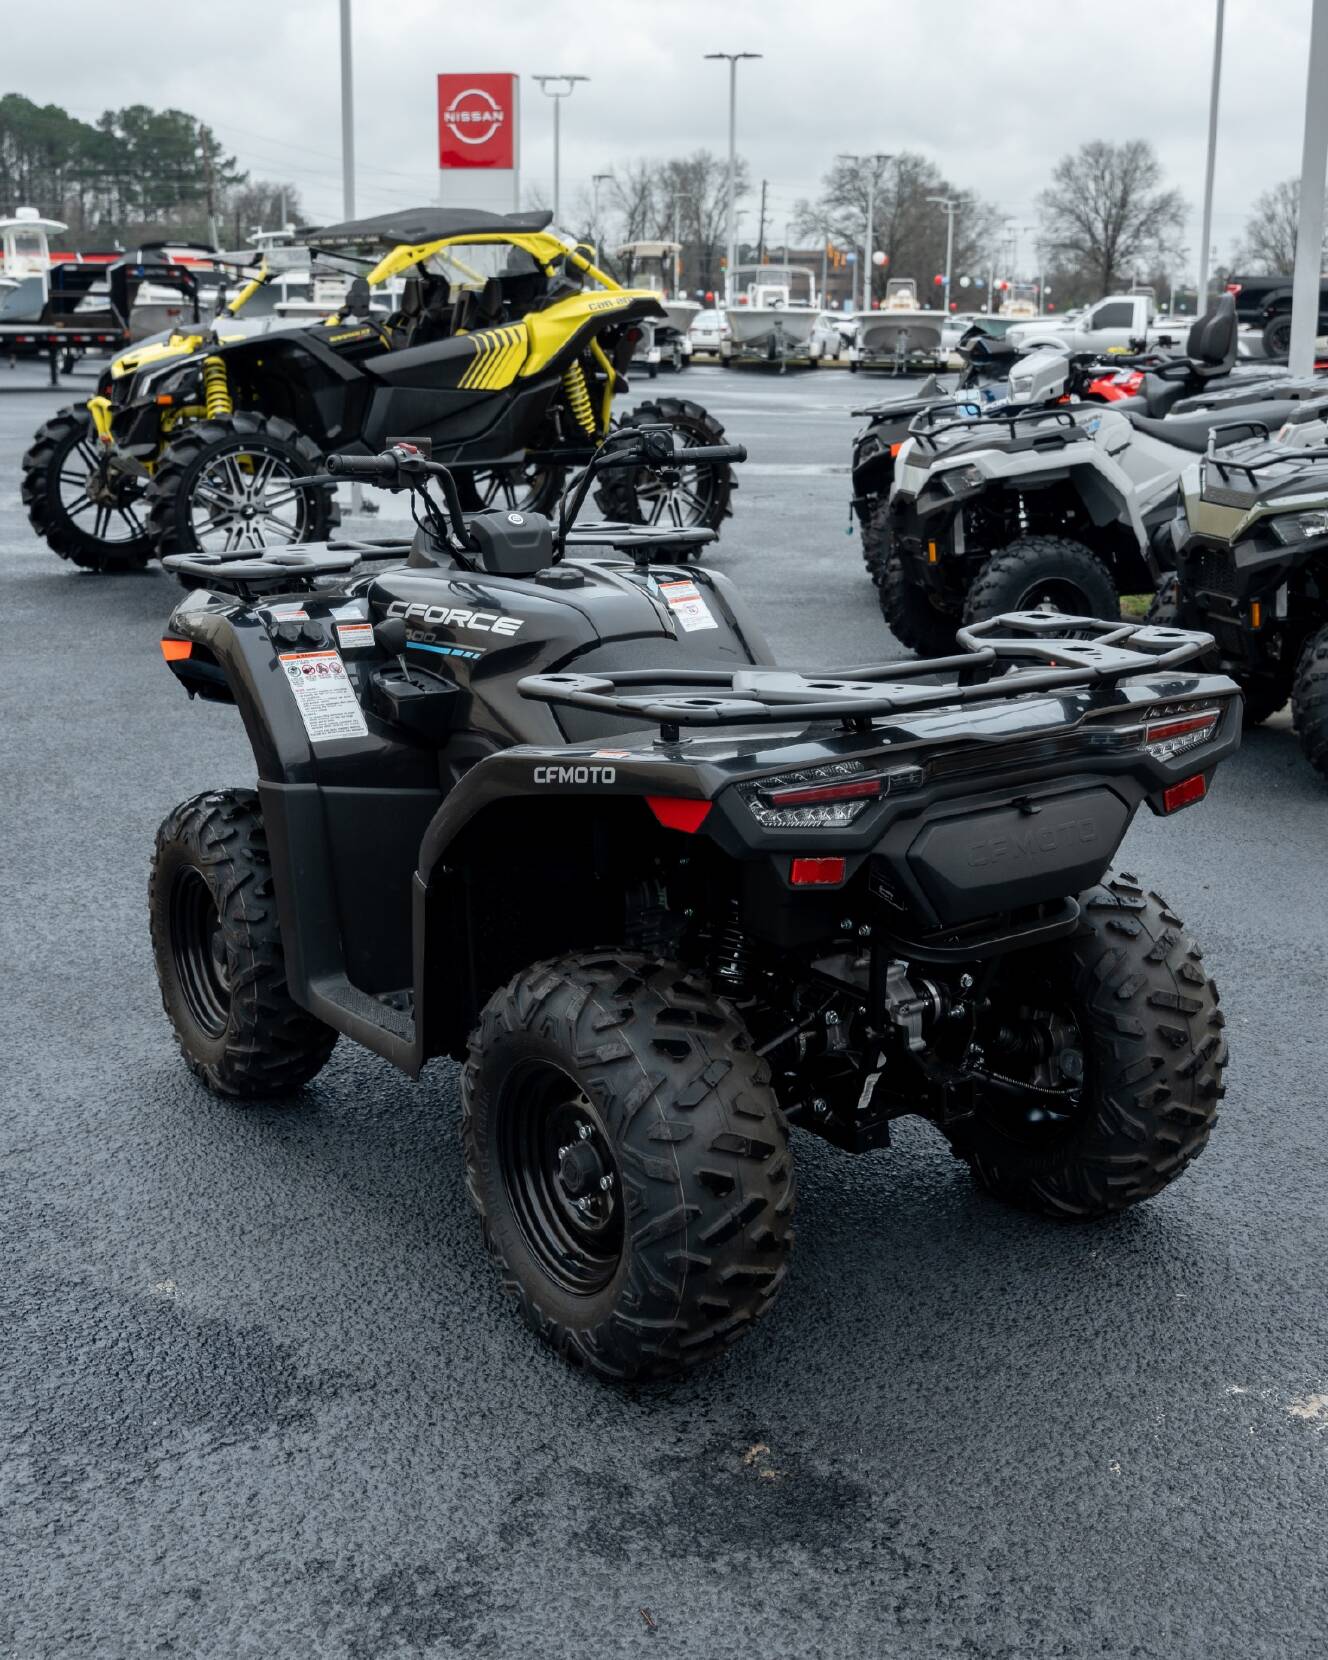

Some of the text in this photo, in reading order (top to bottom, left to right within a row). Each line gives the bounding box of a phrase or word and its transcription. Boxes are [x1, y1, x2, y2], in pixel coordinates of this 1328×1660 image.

[444, 111, 504, 122] NISSAN
[386, 600, 525, 636] CFORCE
[533, 766, 616, 784] CFMOTO
[967, 817, 1098, 868] CFMOTO
